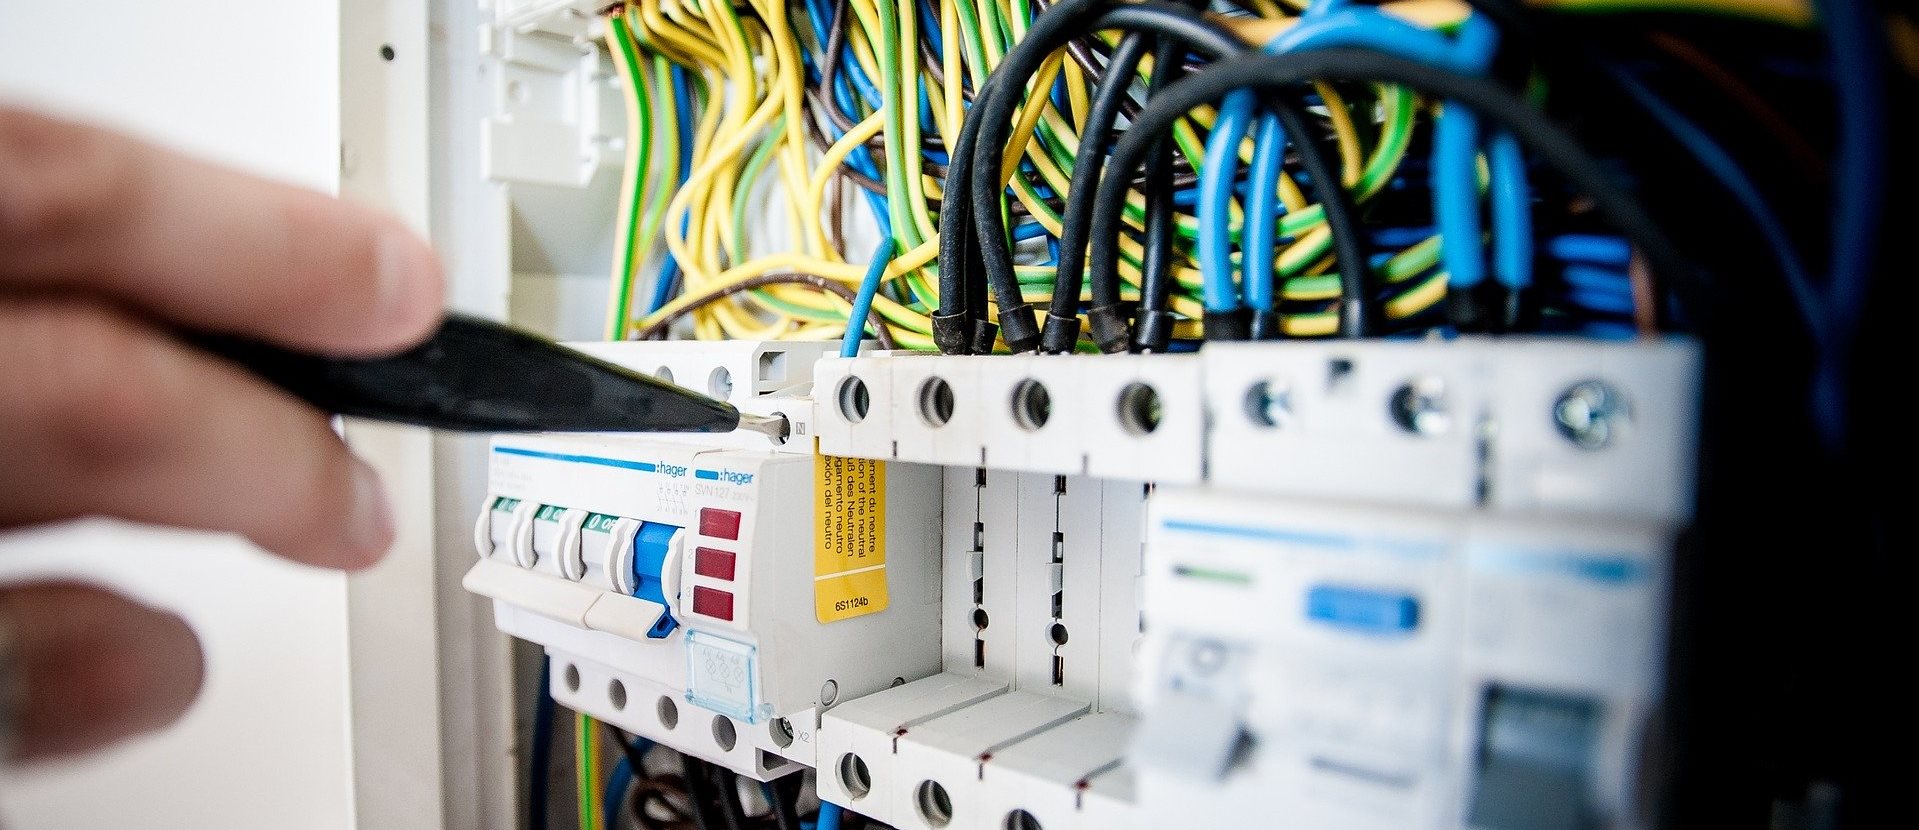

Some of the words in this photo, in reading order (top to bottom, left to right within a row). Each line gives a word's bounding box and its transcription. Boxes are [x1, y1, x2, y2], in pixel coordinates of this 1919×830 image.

[847, 476, 855, 497] des
[858, 483, 866, 493] of
[858, 497, 866, 516] the
[868, 498, 877, 513] du
[825, 511, 833, 549] neutro
[847, 501, 855, 557] Neutralen
[858, 520, 867, 558] neutral
[868, 516, 877, 552] neutre
[835, 597, 869, 611] 6S1124b
